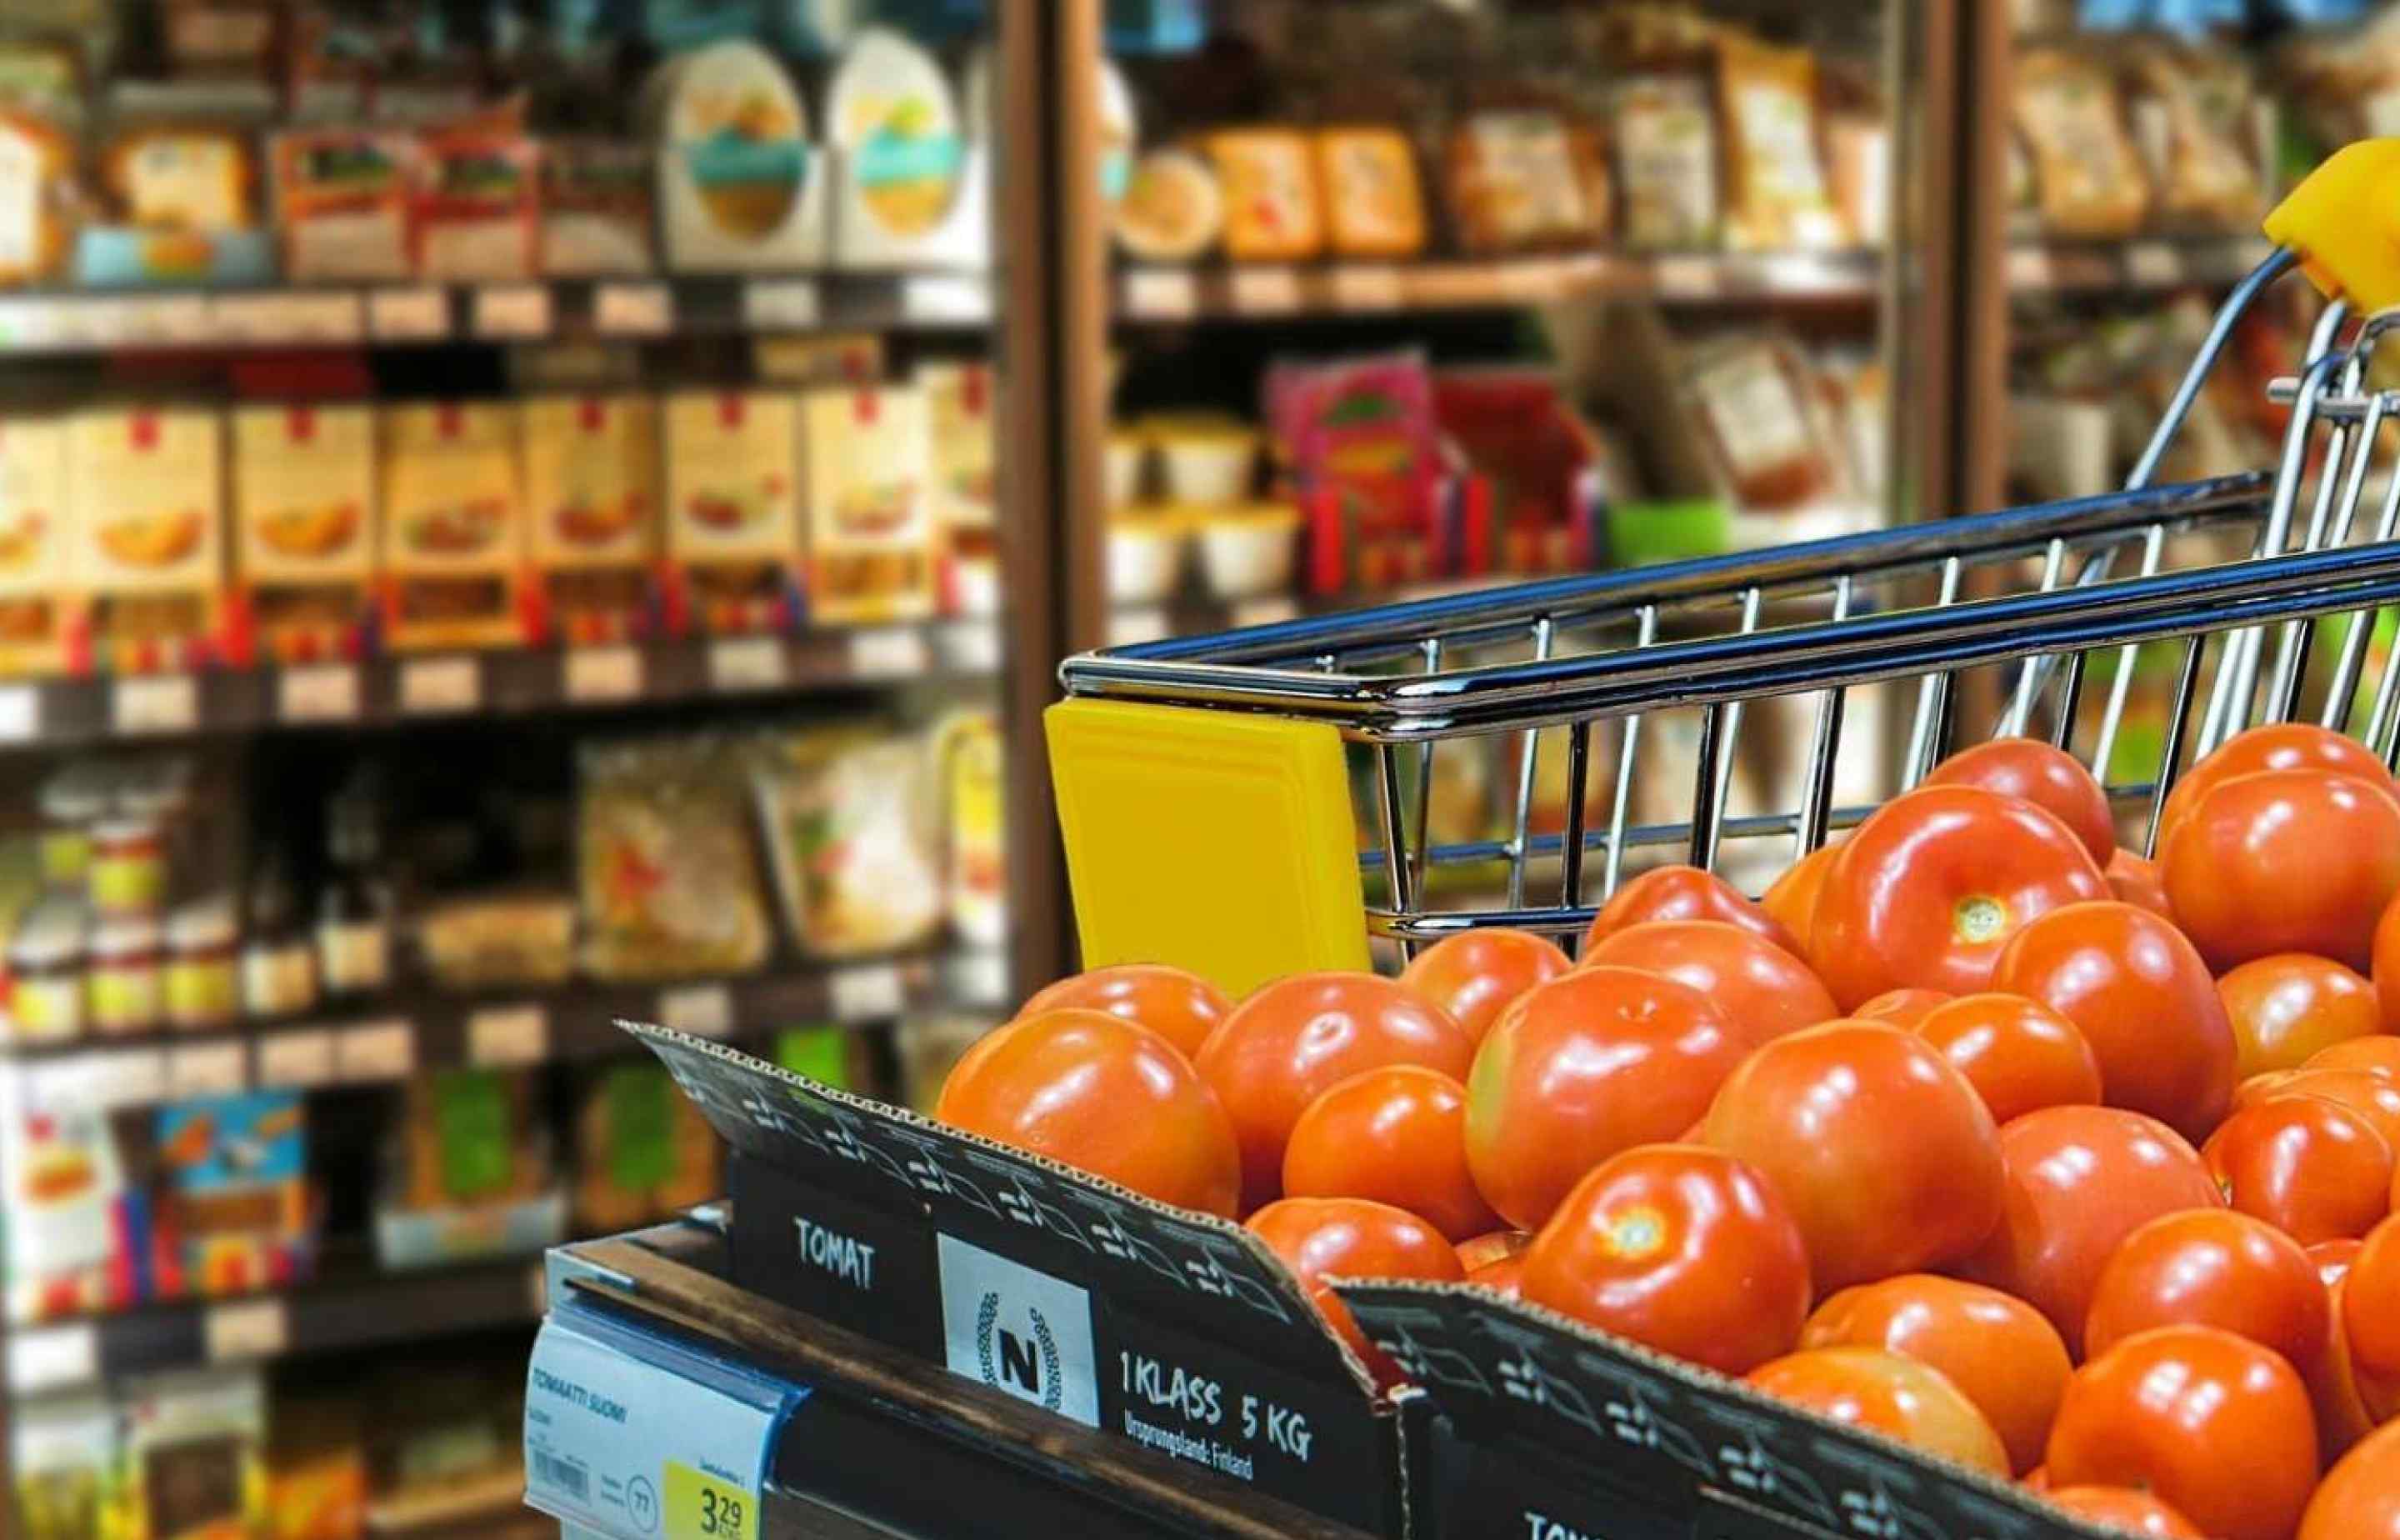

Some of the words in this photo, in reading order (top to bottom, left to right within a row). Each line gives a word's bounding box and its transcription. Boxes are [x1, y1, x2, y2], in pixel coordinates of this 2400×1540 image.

[793, 1216, 875, 1290] TOMAT
[998, 1328, 1039, 1395] N
[1121, 1351, 1129, 1393] 1
[1135, 1356, 1222, 1426] KLASS
[1242, 1394, 1258, 1439] 5
[1267, 1403, 1312, 1462] KG
